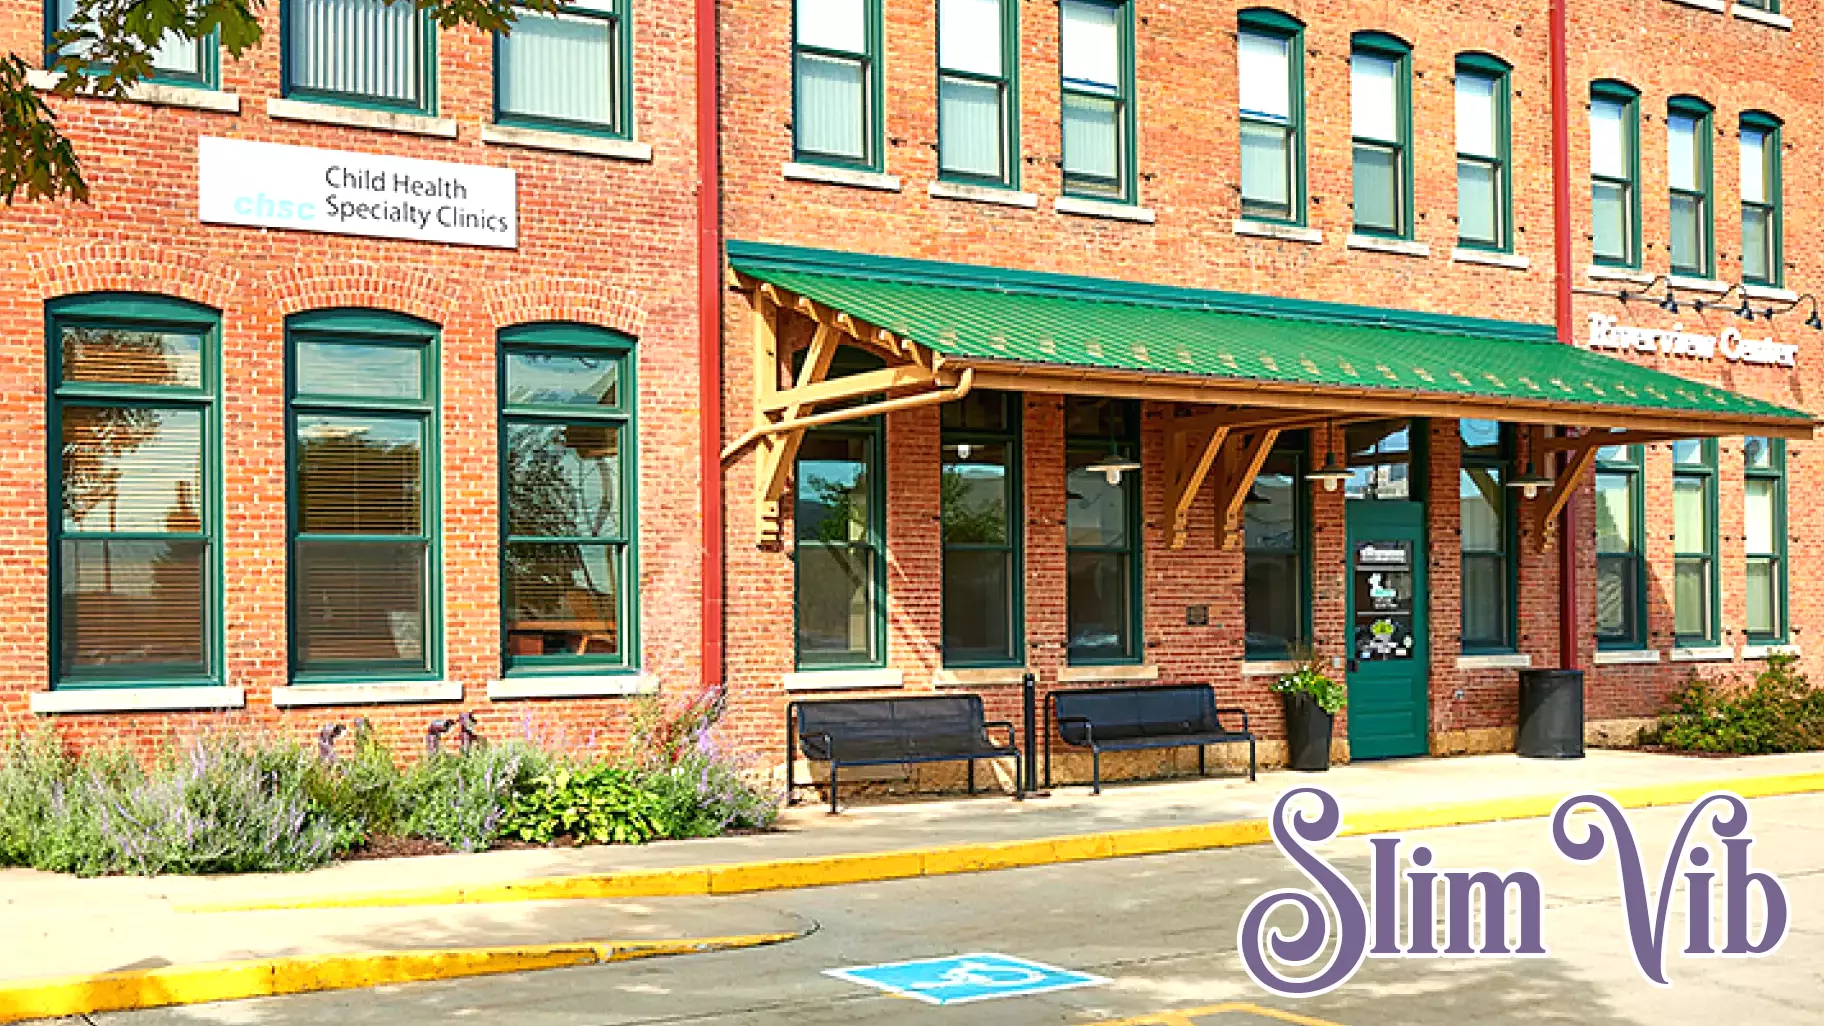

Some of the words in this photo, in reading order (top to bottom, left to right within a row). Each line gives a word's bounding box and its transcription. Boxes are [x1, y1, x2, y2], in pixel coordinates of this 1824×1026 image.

[325, 165, 386, 191] Child
[393, 173, 467, 200] Health
[233, 192, 317, 221] chsc
[325, 194, 431, 229] Specialty
[436, 205, 509, 232] Clinics
[1720, 327, 1798, 366] Center
